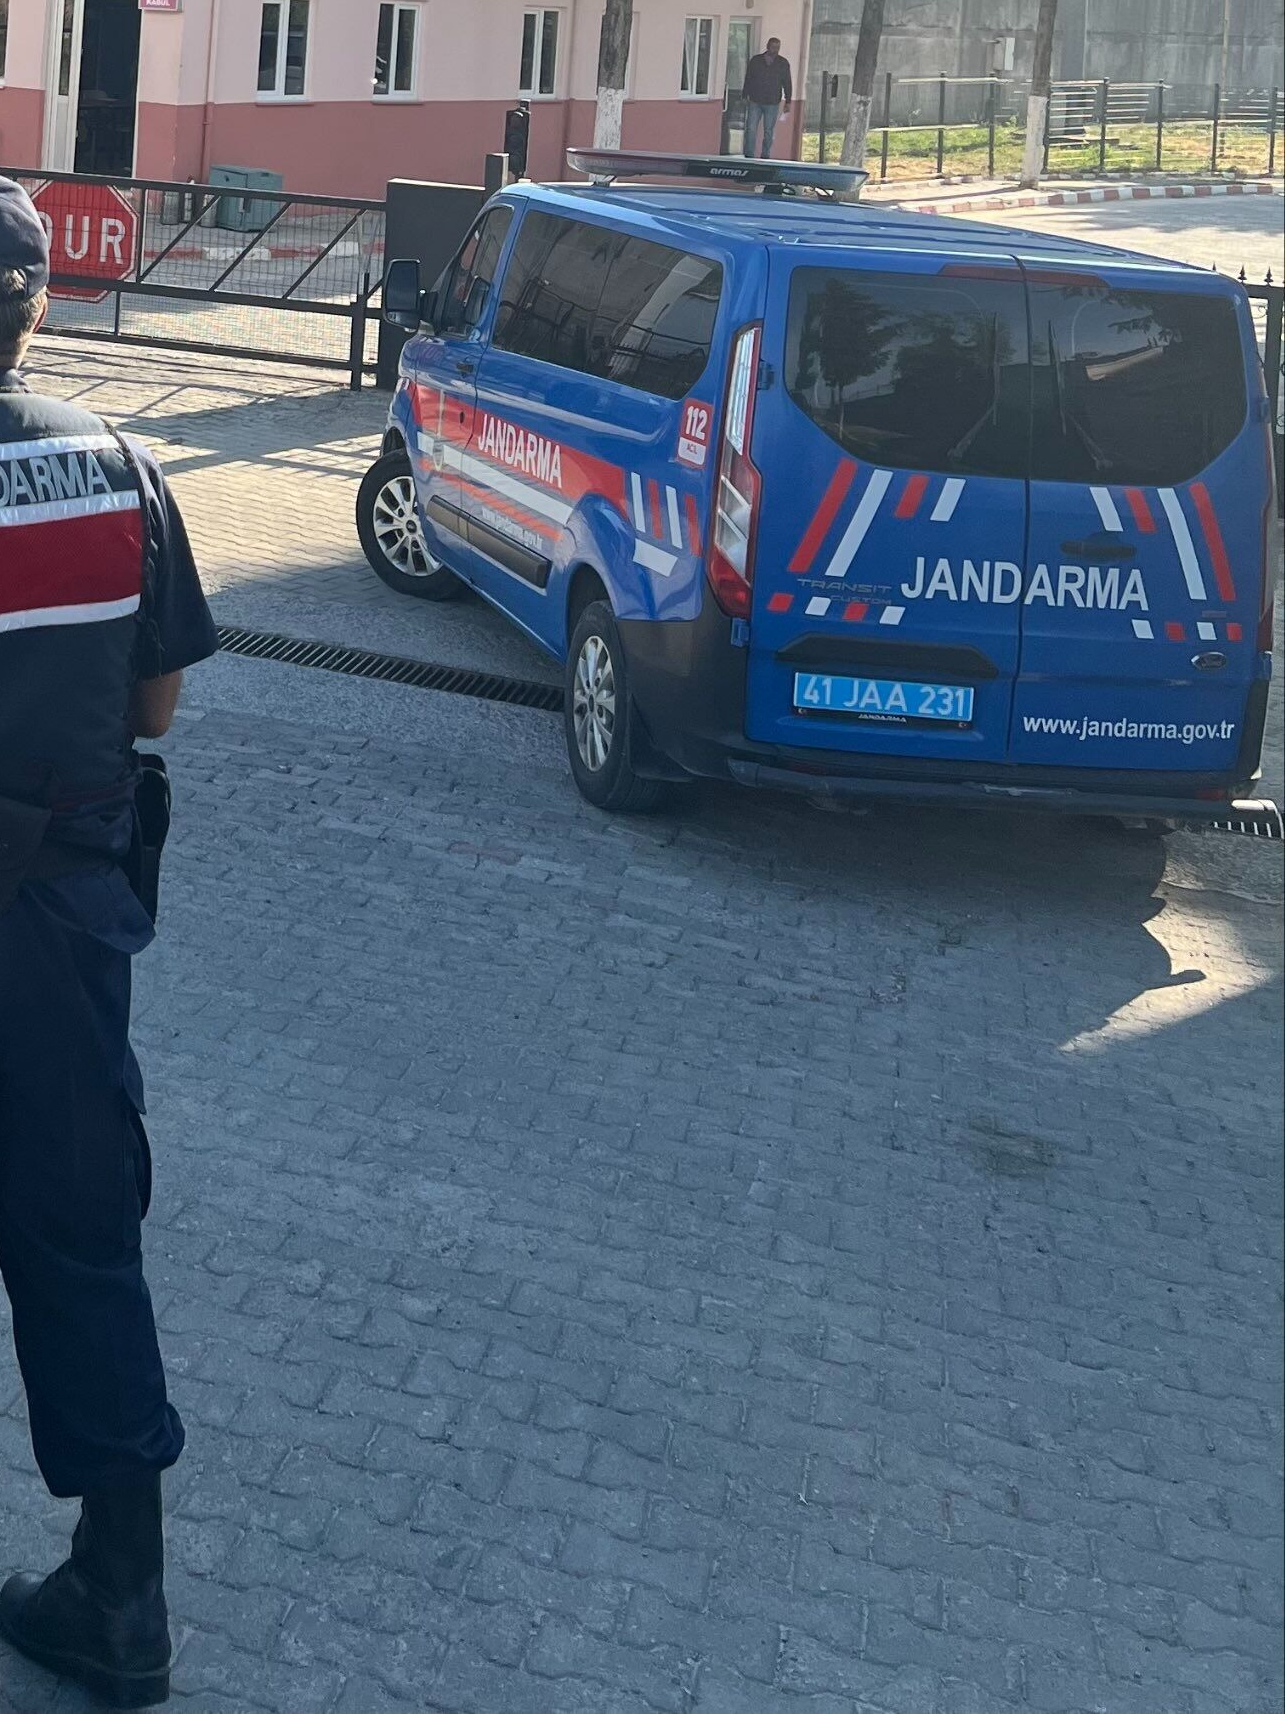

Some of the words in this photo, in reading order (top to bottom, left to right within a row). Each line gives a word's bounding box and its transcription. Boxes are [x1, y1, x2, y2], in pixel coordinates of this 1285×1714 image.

[710, 167, 749, 177] armas
[685, 406, 708, 440] 112
[478, 413, 563, 488] JANDARMA
[797, 578, 892, 593] TRANSIT
[901, 557, 1149, 611] JANDARMA
[803, 676, 833, 705] 41
[843, 679, 908, 712] JAA
[918, 687, 964, 717] 231
[858, 713, 907, 723] JANDARMA
[1023, 716, 1235, 744] www.jandarma.gov.tr
